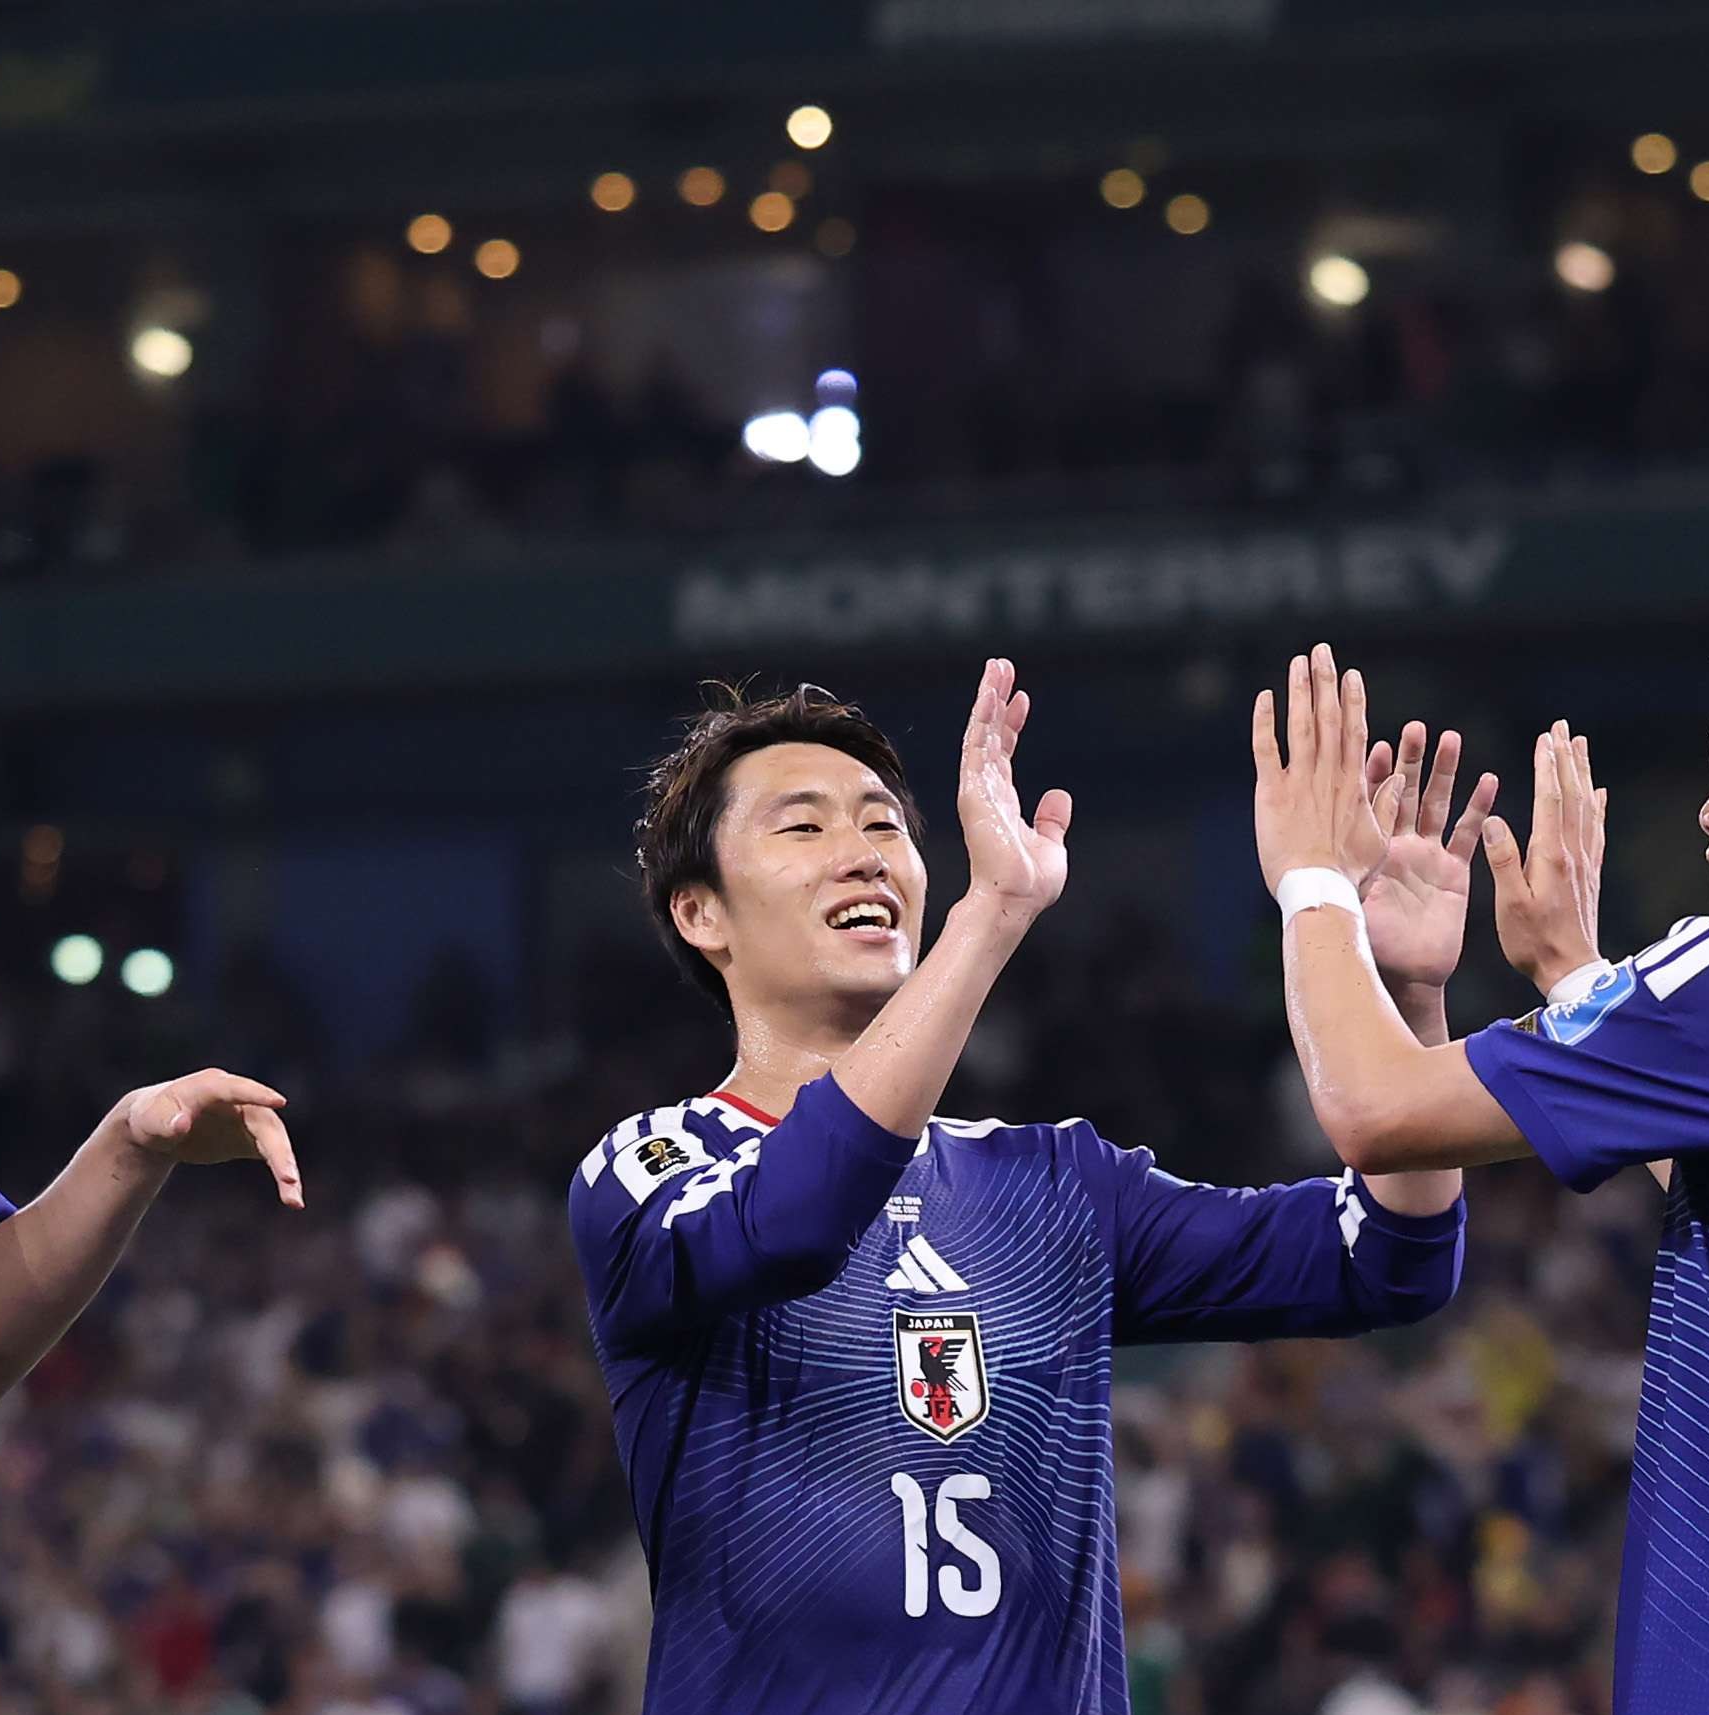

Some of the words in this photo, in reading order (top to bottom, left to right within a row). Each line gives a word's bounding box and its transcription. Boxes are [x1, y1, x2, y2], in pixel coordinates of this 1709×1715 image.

[908, 1318, 954, 1329] JAPAN
[922, 1400, 963, 1419] JFA
[890, 1472, 1002, 1618] 15
